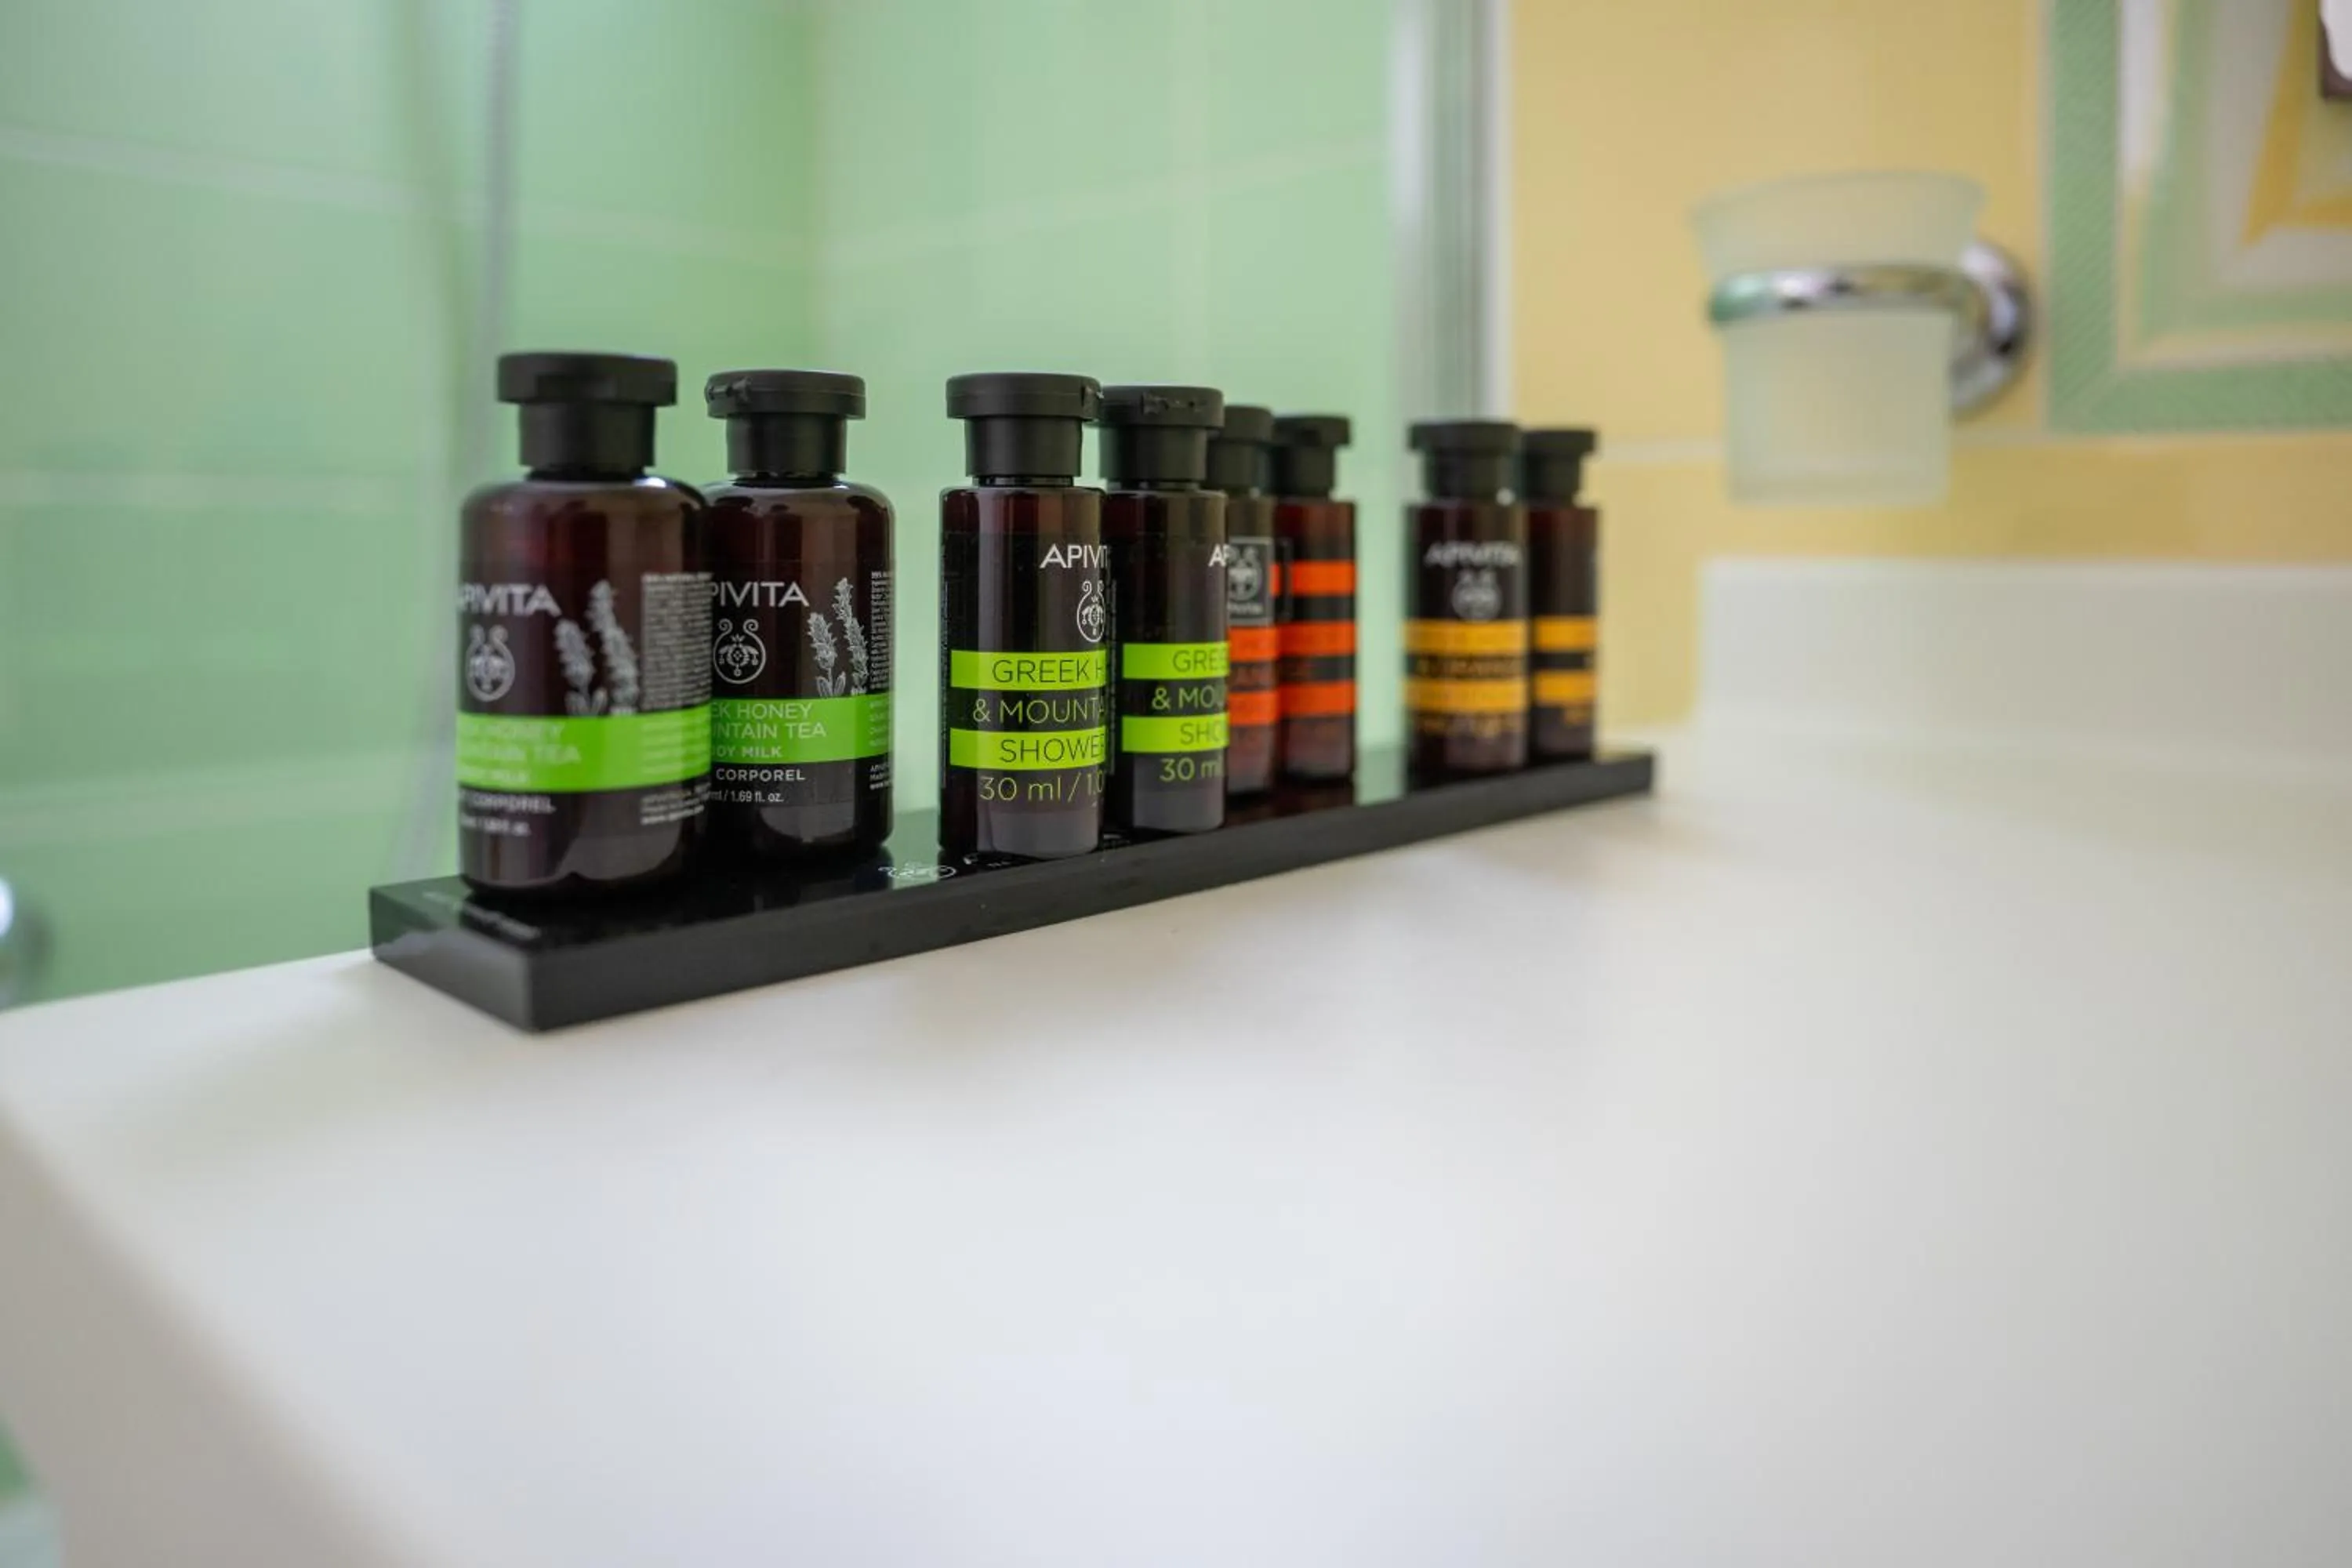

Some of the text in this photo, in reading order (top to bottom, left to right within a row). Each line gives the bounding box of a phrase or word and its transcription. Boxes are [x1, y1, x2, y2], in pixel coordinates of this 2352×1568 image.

[992, 659, 1090, 684] GREEK
[972, 698, 991, 722] &
[1152, 686, 1171, 710] &
[737, 702, 813, 720] HONEY
[786, 722, 827, 739] TEA
[742, 746, 782, 758] MILK
[716, 768, 805, 782] CORPOREL
[1160, 757, 1195, 782] 30
[979, 775, 1018, 800] 30
[1027, 775, 1062, 800] ml
[1067, 771, 1082, 802] /
